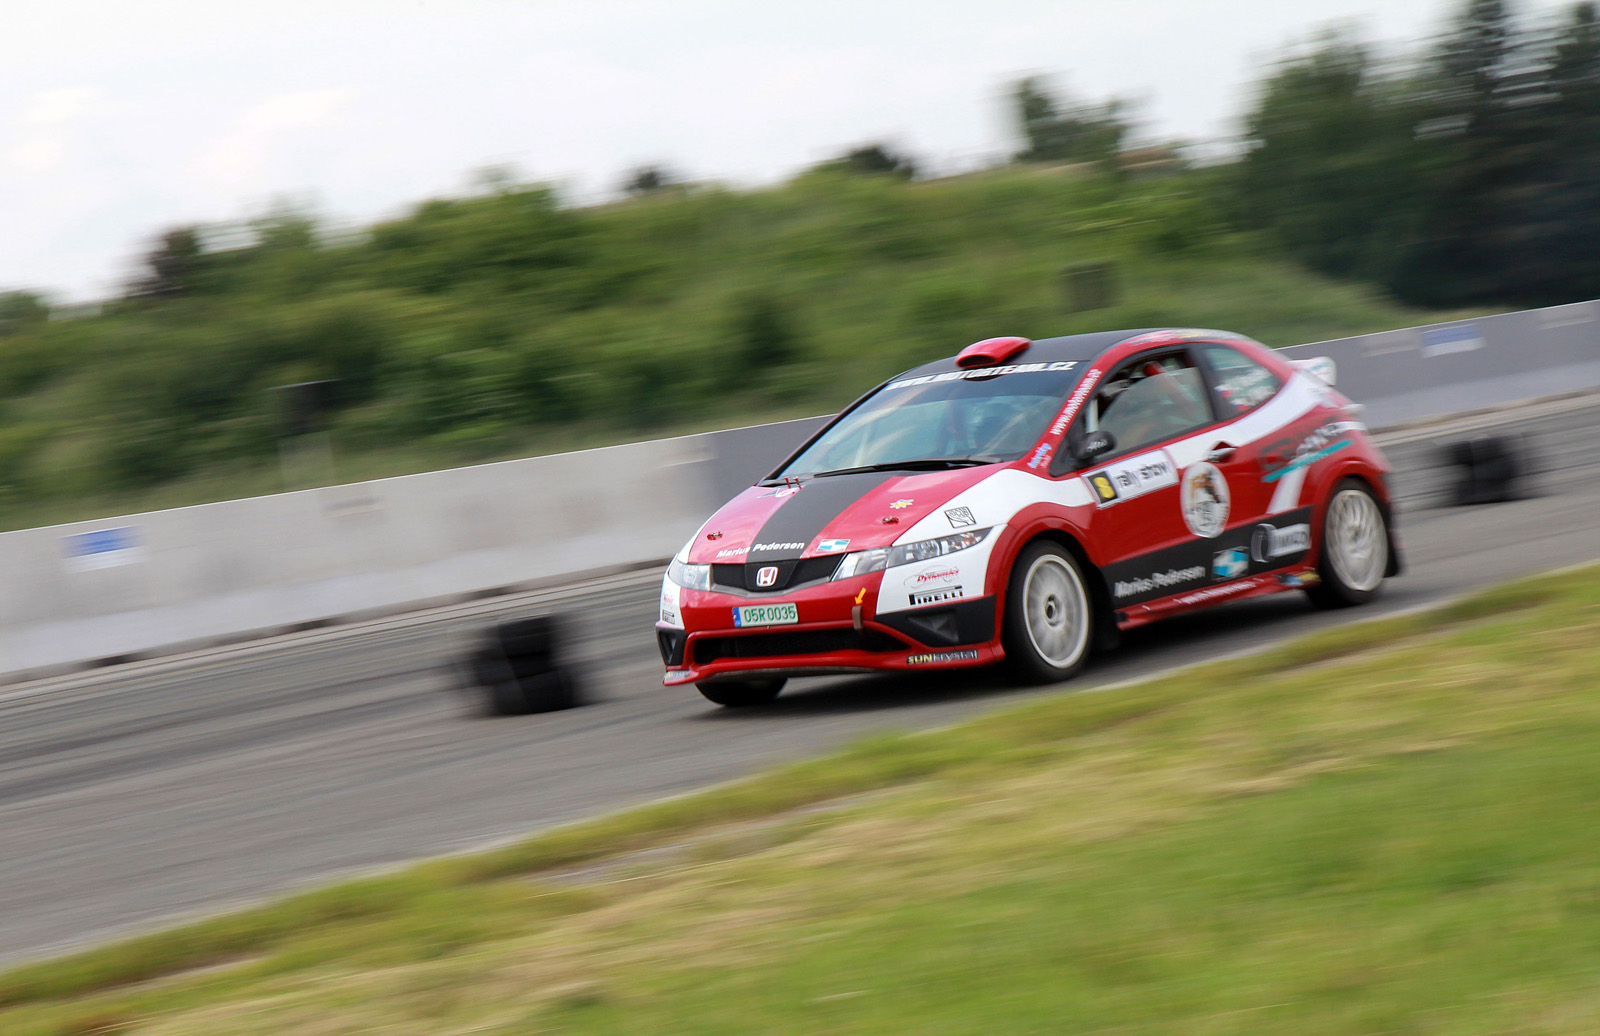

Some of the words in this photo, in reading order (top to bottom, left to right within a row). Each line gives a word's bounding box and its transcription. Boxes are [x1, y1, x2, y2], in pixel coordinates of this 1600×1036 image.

[716, 546, 750, 558] Marius
[753, 541, 806, 552] Pedersen
[908, 585, 964, 605] PIRELLI
[744, 607, 765, 623] 05R
[767, 605, 797, 621] 0035
